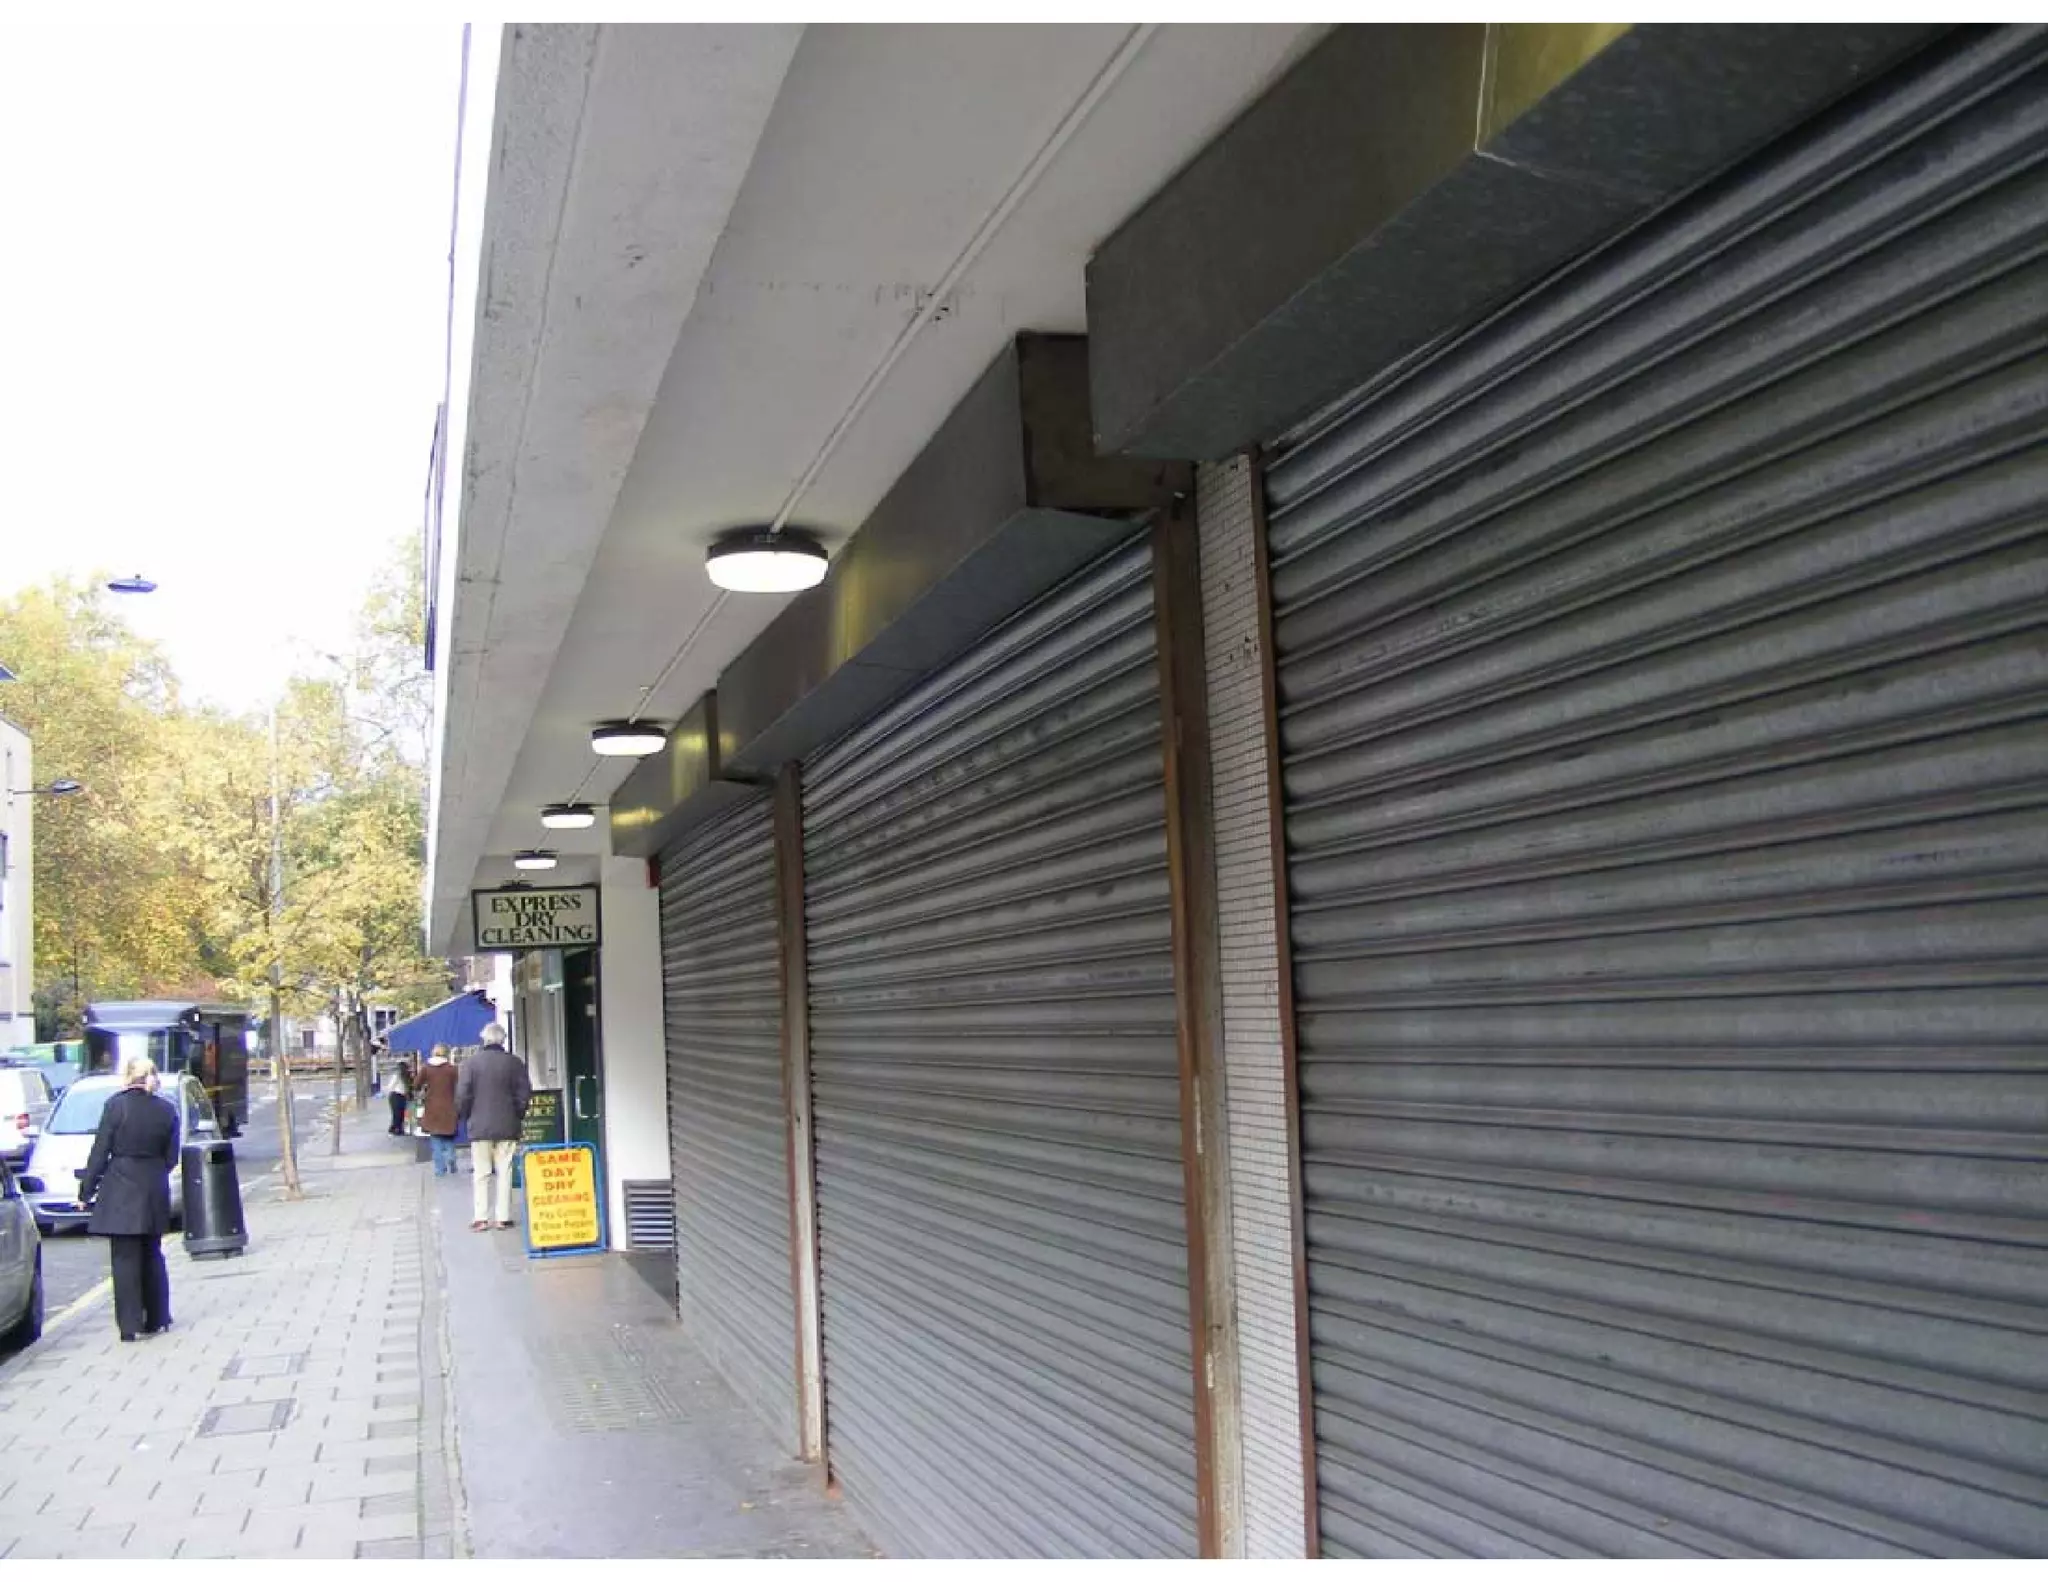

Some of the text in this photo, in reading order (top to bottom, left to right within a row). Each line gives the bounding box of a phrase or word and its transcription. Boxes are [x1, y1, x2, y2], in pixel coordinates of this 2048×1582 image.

[491, 894, 582, 913] EXPRESS
[515, 911, 557, 927] DRY
[482, 925, 592, 943] CLEANING
[536, 1152, 581, 1166] SAME
[541, 1167, 575, 1178] DAY
[543, 1179, 576, 1191] DRY
[532, 1191, 590, 1207] CLEANING
